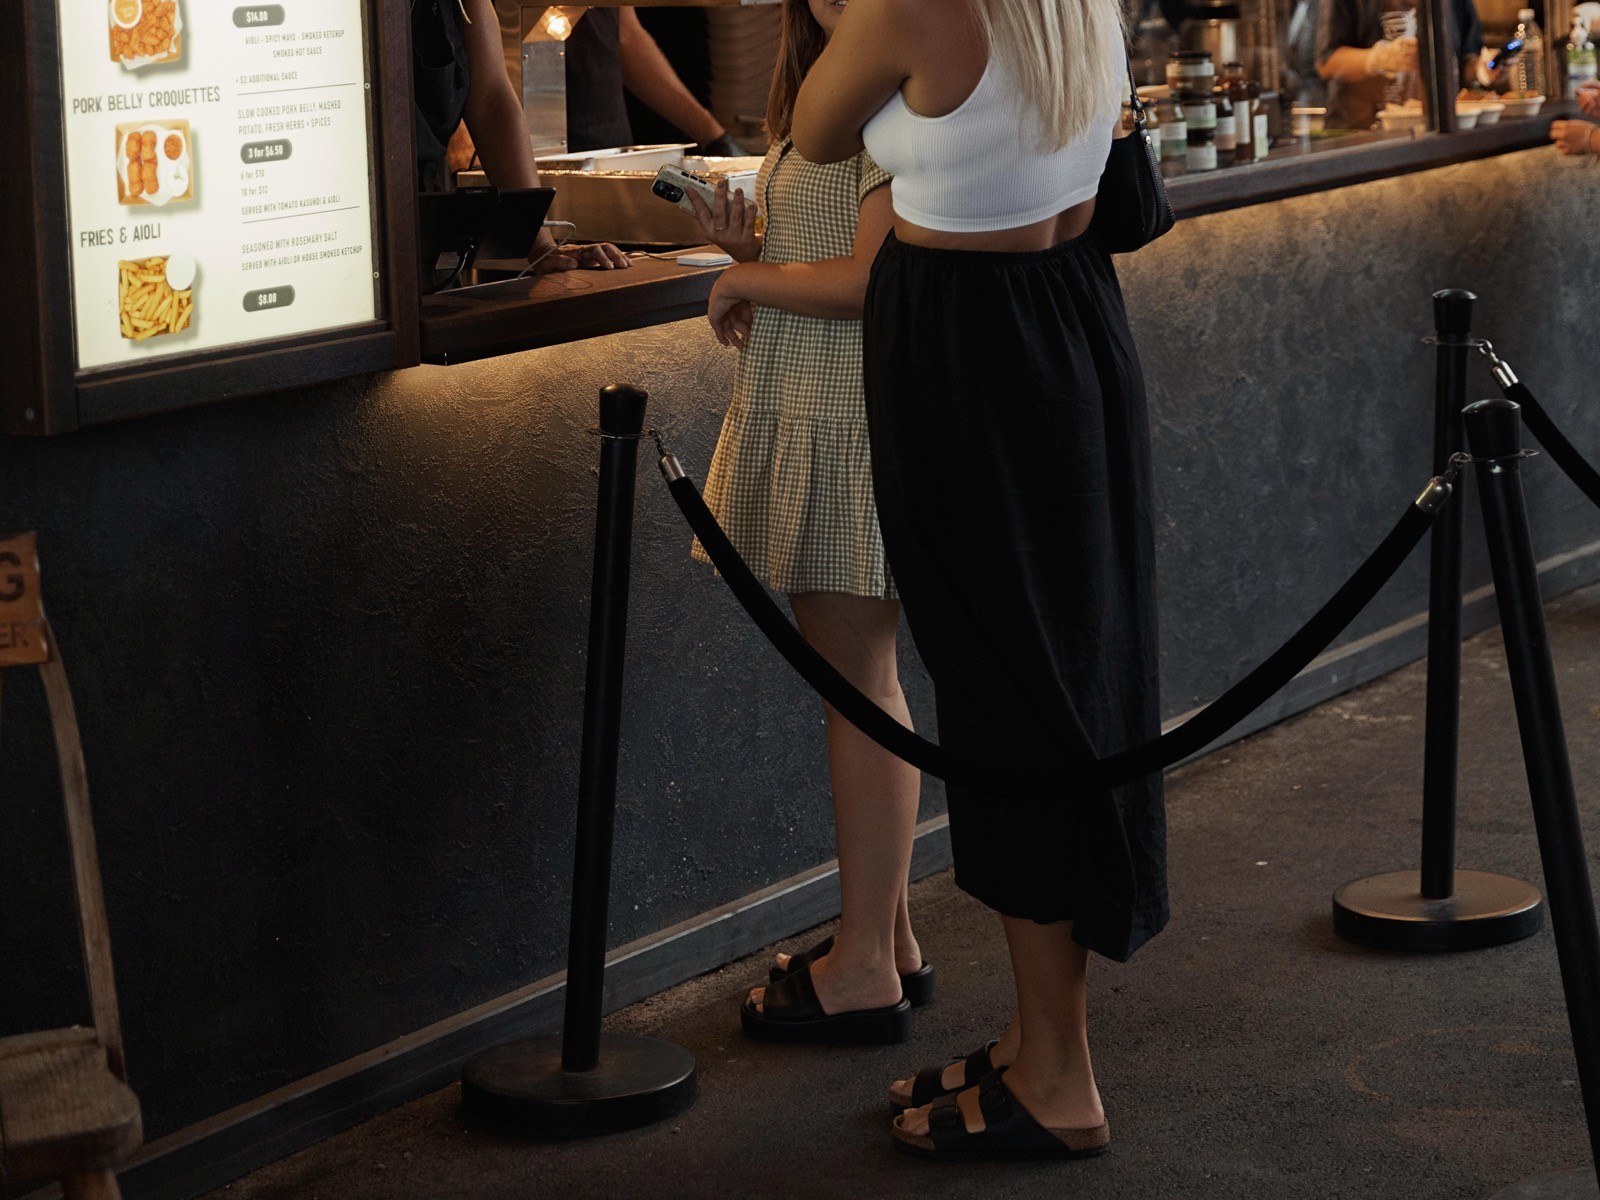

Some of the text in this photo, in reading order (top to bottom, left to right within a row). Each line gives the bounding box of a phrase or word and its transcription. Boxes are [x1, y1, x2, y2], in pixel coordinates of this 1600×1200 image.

[247, 11, 268, 22] $14.00
[245, 30, 344, 45] AIOLI SPICY MAYO SMOKED KETCHUP
[273, 46, 322, 58] SMOKED HOT SAUCE
[249, 71, 298, 84] ADDITIONAL SAUCE
[72, 86, 220, 115] PORK BELLY CROQUETTES
[238, 108, 254, 119] SLOW
[257, 106, 280, 117] COOKED
[282, 104, 298, 115] PORK
[319, 100, 341, 111] MASHED
[265, 122, 284, 133] FRESH
[286, 120, 304, 131] HERBS
[311, 117, 330, 128] SPICES
[254, 145, 283, 157] for $6.50
[249, 187, 257, 196] for
[242, 205, 262, 215] SERVED
[264, 204, 276, 213] WITH
[278, 200, 298, 211] TOMATO
[328, 195, 340, 204] AIOLI
[80, 223, 161, 248] FRIES & AIOLI
[242, 231, 338, 254] SEASONED WITH ROSEMARY SALT
[242, 245, 362, 271] SERVED WITH AIOLI OR HOUSE SMOKED KETCHUP
[259, 293, 276, 306] $8.00
